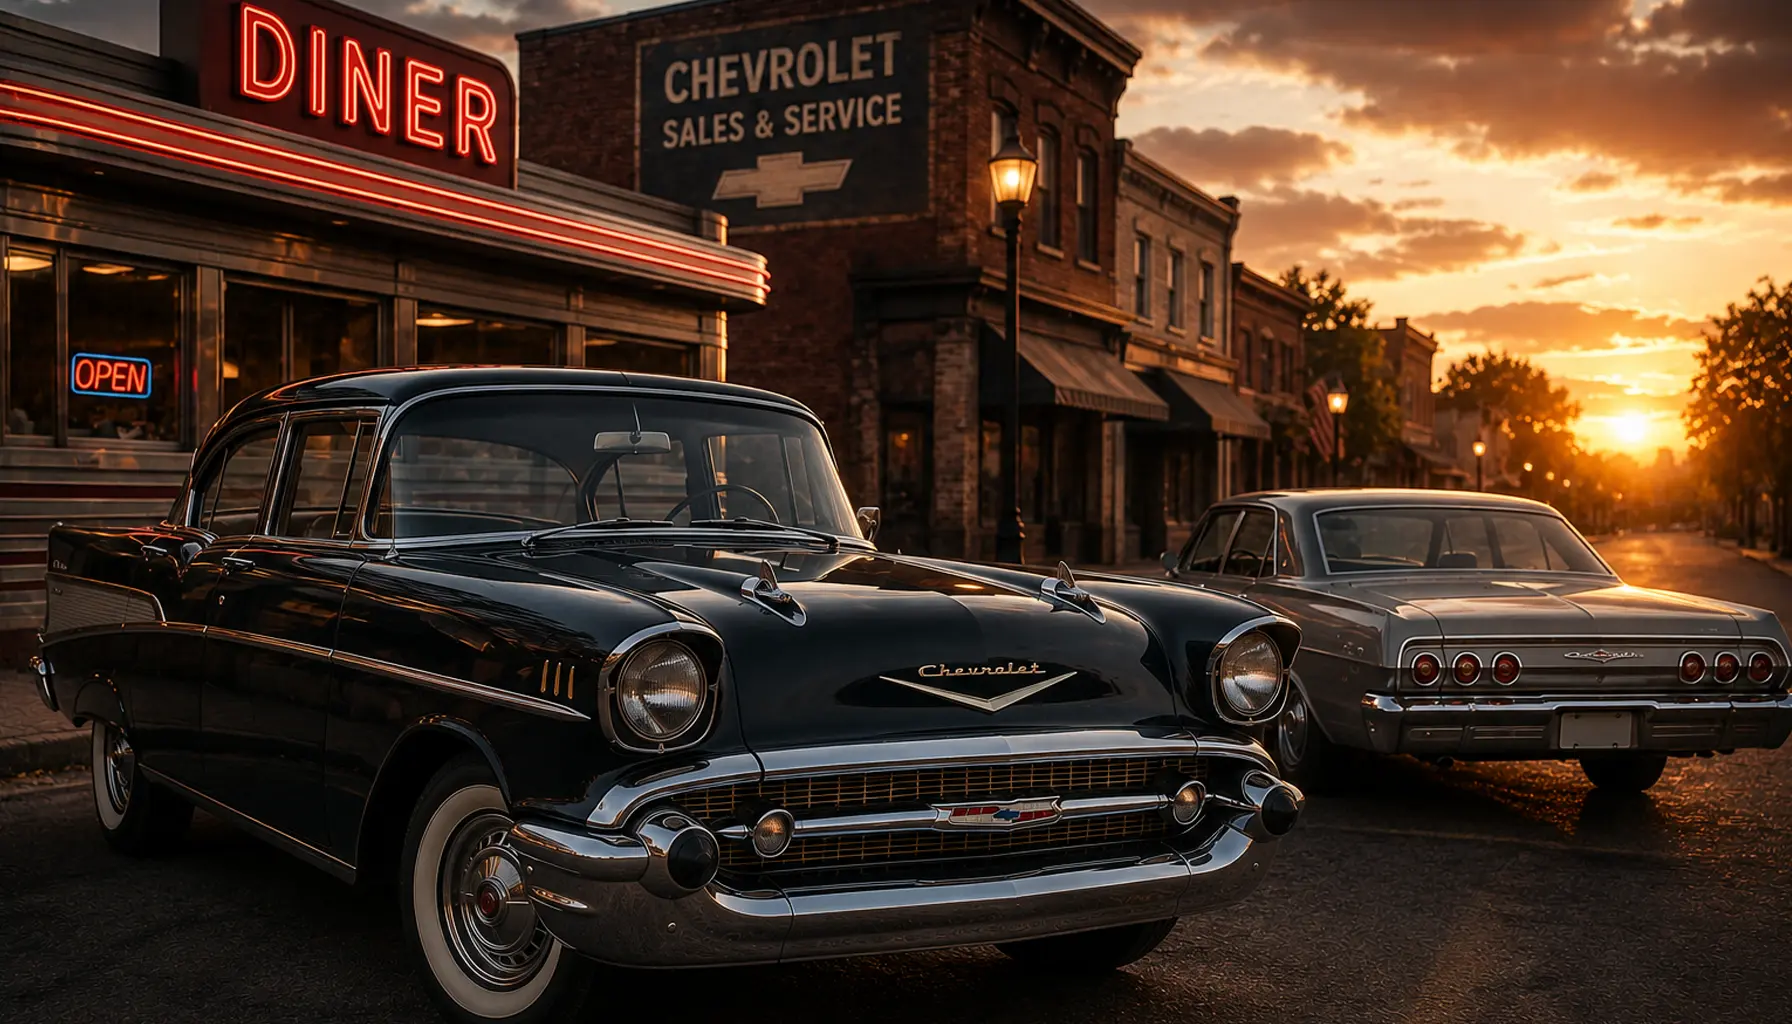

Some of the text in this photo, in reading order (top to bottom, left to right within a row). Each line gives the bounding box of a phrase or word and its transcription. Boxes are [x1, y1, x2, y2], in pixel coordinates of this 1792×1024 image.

[240, 4, 497, 164] DINER
[664, 31, 902, 105] CHEVROLET
[663, 93, 903, 149] SALES & SERVICE
[76, 360, 146, 393] OPEN
[918, 662, 1046, 677] Chevrolet
